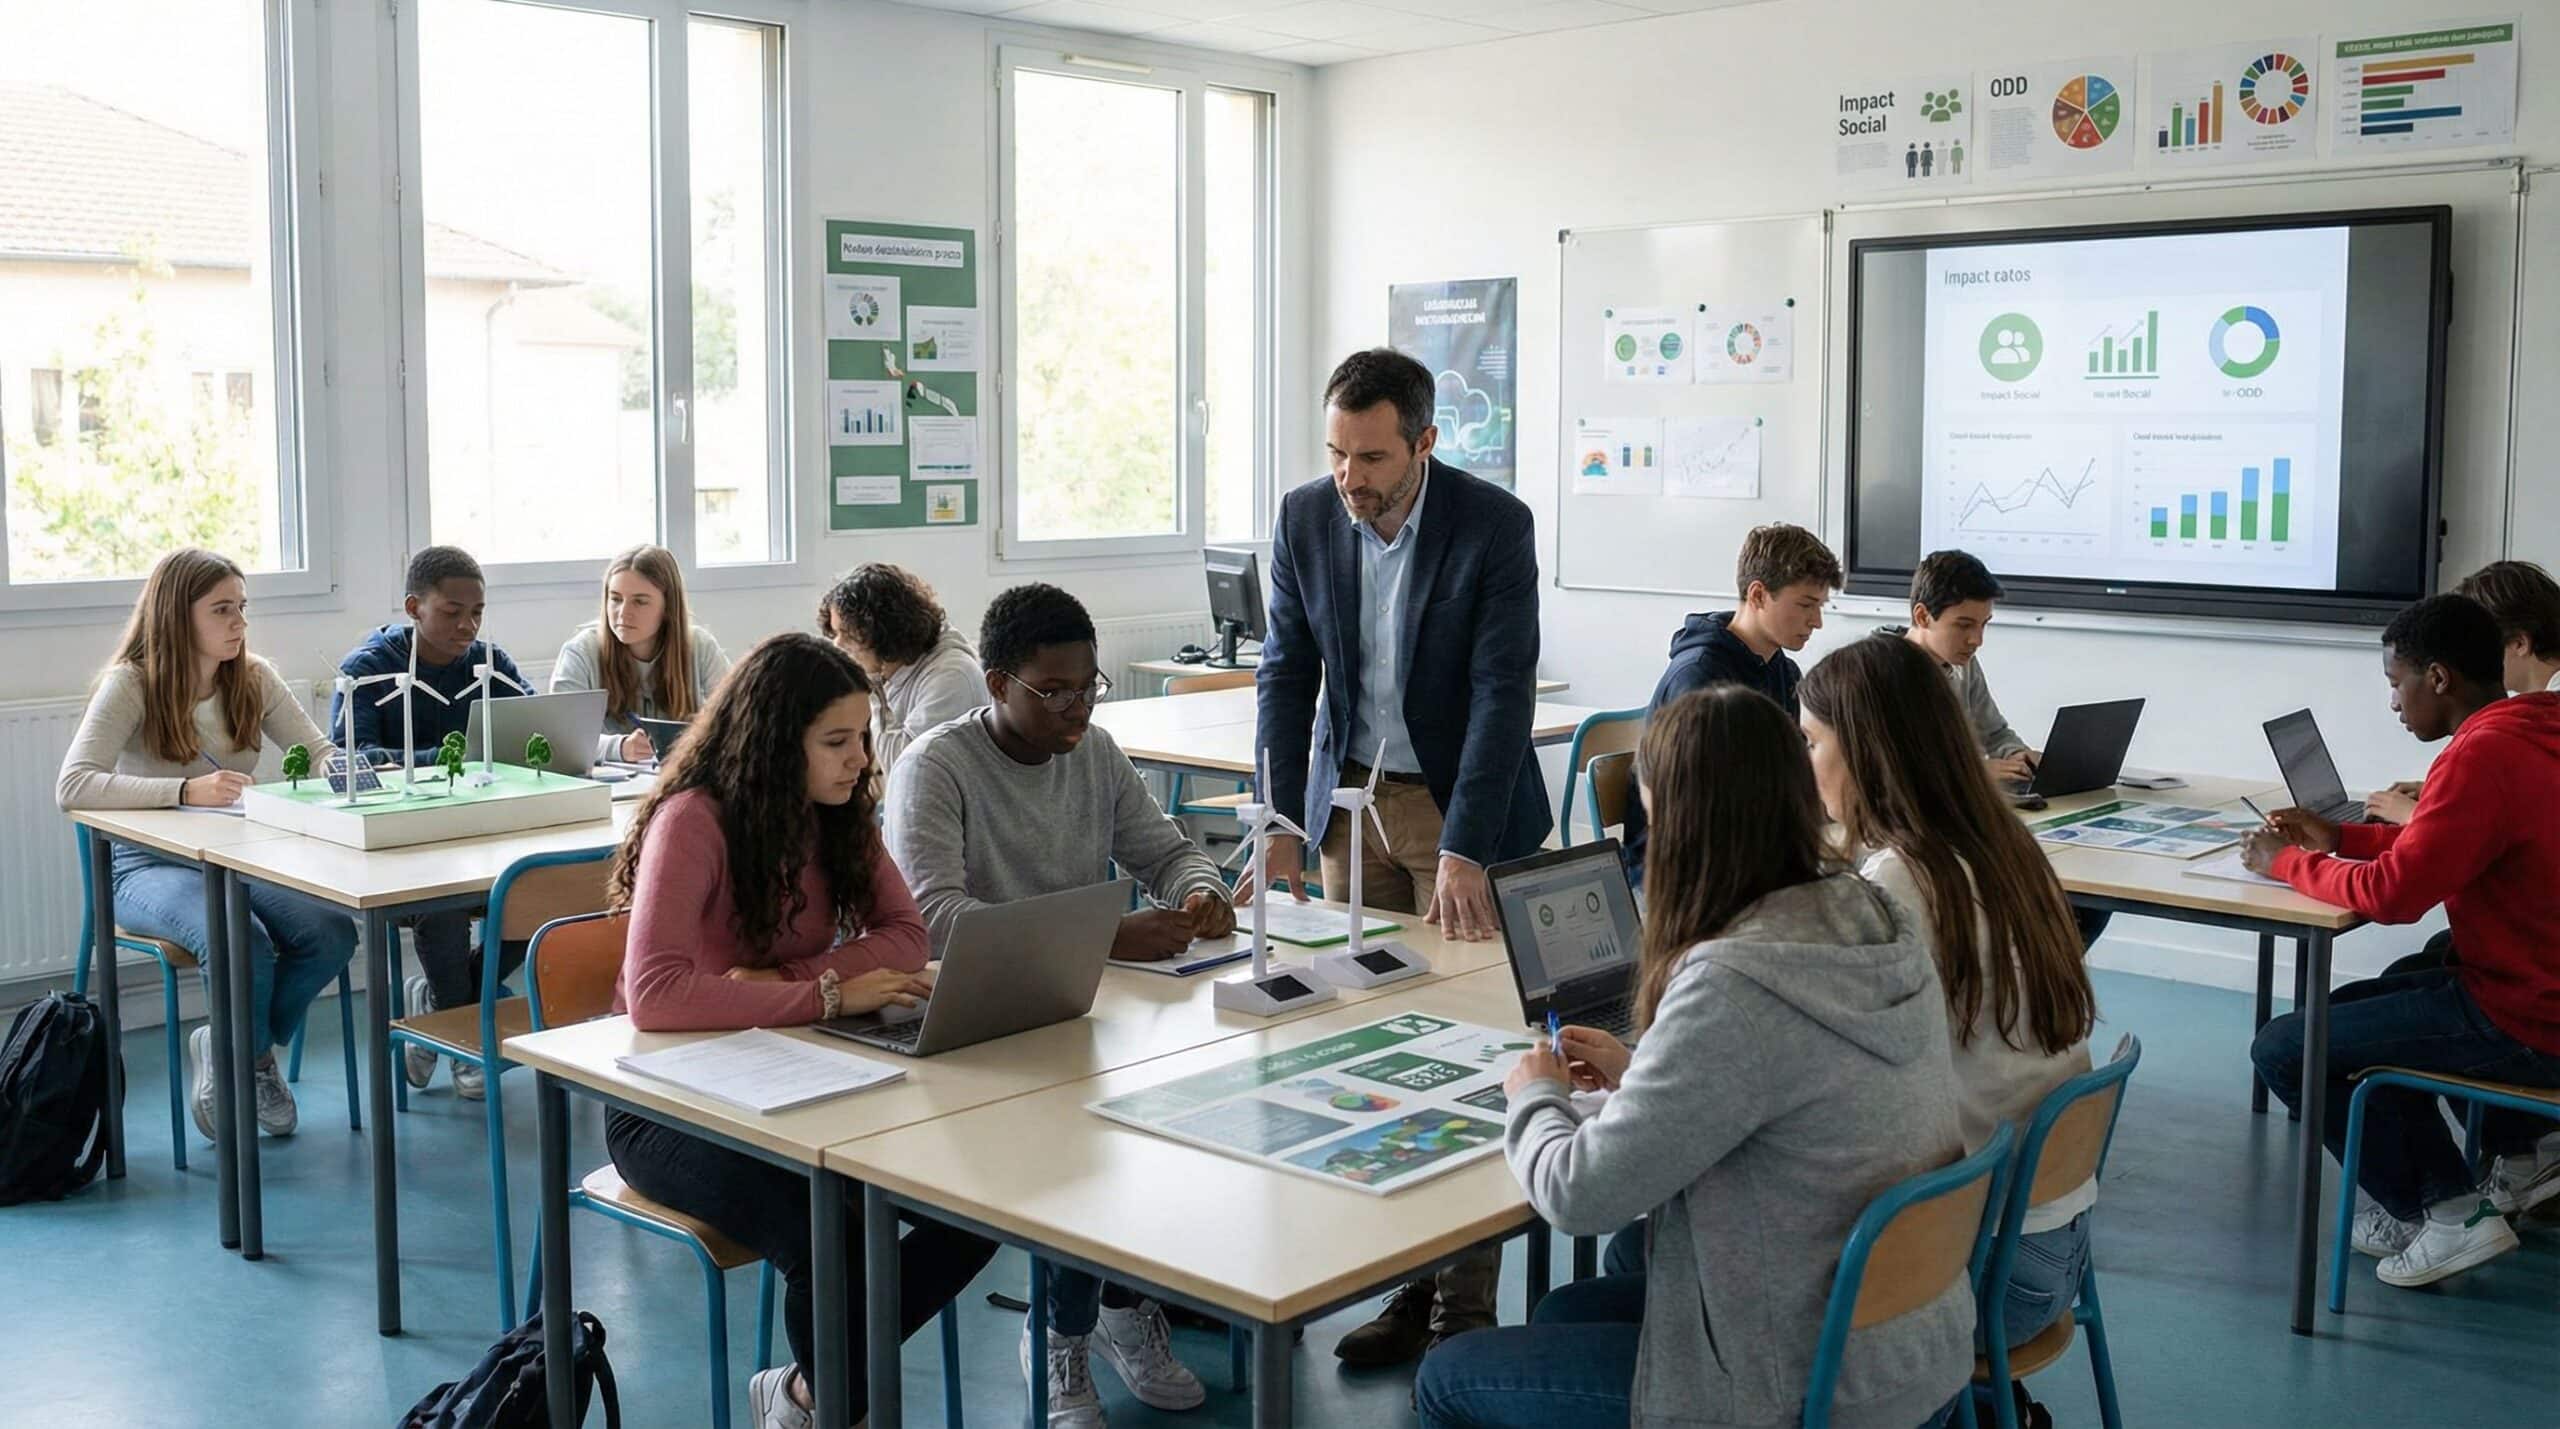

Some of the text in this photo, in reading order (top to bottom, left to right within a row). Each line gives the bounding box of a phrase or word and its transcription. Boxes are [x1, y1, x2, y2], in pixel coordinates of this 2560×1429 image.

[1991, 76, 2028, 97] ODD
[1839, 91, 1895, 115] Impact
[1839, 114, 1887, 136] Social
[1944, 269, 1990, 288] Impact
